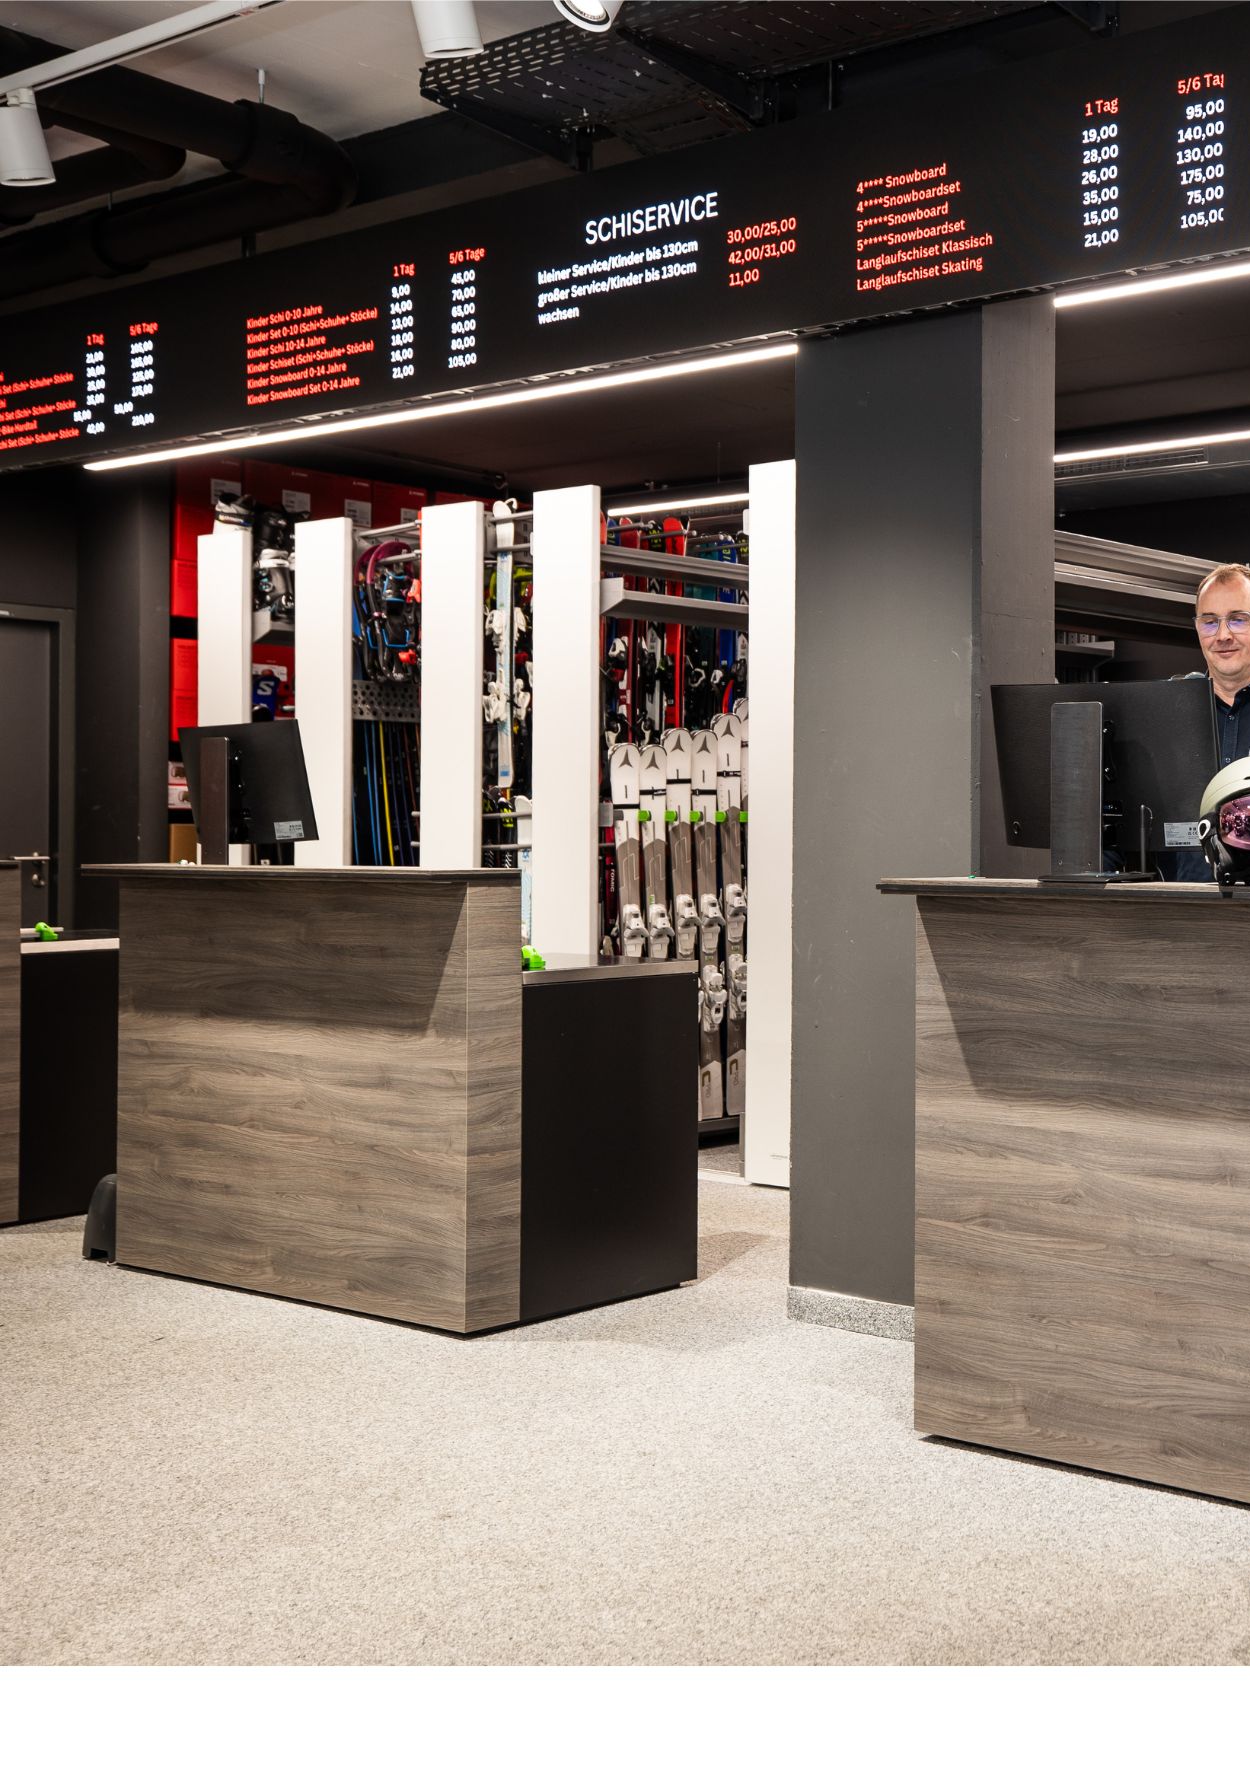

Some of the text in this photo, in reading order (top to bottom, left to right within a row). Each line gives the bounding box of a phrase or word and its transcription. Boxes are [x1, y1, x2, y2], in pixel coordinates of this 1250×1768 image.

[1178, 76, 1201, 94] 5/6
[1086, 98, 1118, 116] 1 Tag
[1186, 99, 1224, 120] 95,00
[1083, 124, 1117, 143] 19,00
[1178, 121, 1224, 144] 140,00
[1083, 145, 1118, 164] 28,00
[1177, 142, 1223, 166] 130,00
[885, 163, 946, 188] Snowboard
[1082, 166, 1117, 185] 26,00
[1179, 163, 1224, 187] 175,00
[1083, 186, 1118, 205] 35,00
[1187, 186, 1224, 205] 75,00
[586, 192, 718, 244] SCHISERVICE
[1084, 207, 1118, 226] 15,00
[1181, 208, 1224, 228] 105,00
[727, 217, 796, 244] 30,00/25,00
[1085, 229, 1119, 247] 21,00
[449, 248, 485, 264] 5/6 Tage
[728, 239, 796, 265] 42,00/31,00
[857, 233, 992, 270] Langlaufschiset Klassisch
[394, 264, 415, 277] 1 Tag
[538, 241, 698, 285] kleiner Service/Kinder bis 130cm
[729, 268, 760, 286] 11,00
[857, 257, 983, 290] Langlaufschiset Skating
[538, 262, 696, 307] großer Service/Kinder bis 130cm
[247, 305, 323, 329] Kinder Schi 0-10 Jahre
[538, 307, 579, 324] wachsen
[247, 332, 269, 344] Kinder
[269, 329, 281, 340] Set
[281, 324, 299, 337] 0-10
[247, 336, 326, 359] Kinder Schi 10-14 Jahre
[247, 362, 269, 374] Kinder
[247, 362, 347, 389] Kinder Snowboard 0-14 Jahre
[247, 377, 360, 405] Kinder Snowboard Set 0-14 Jahre
